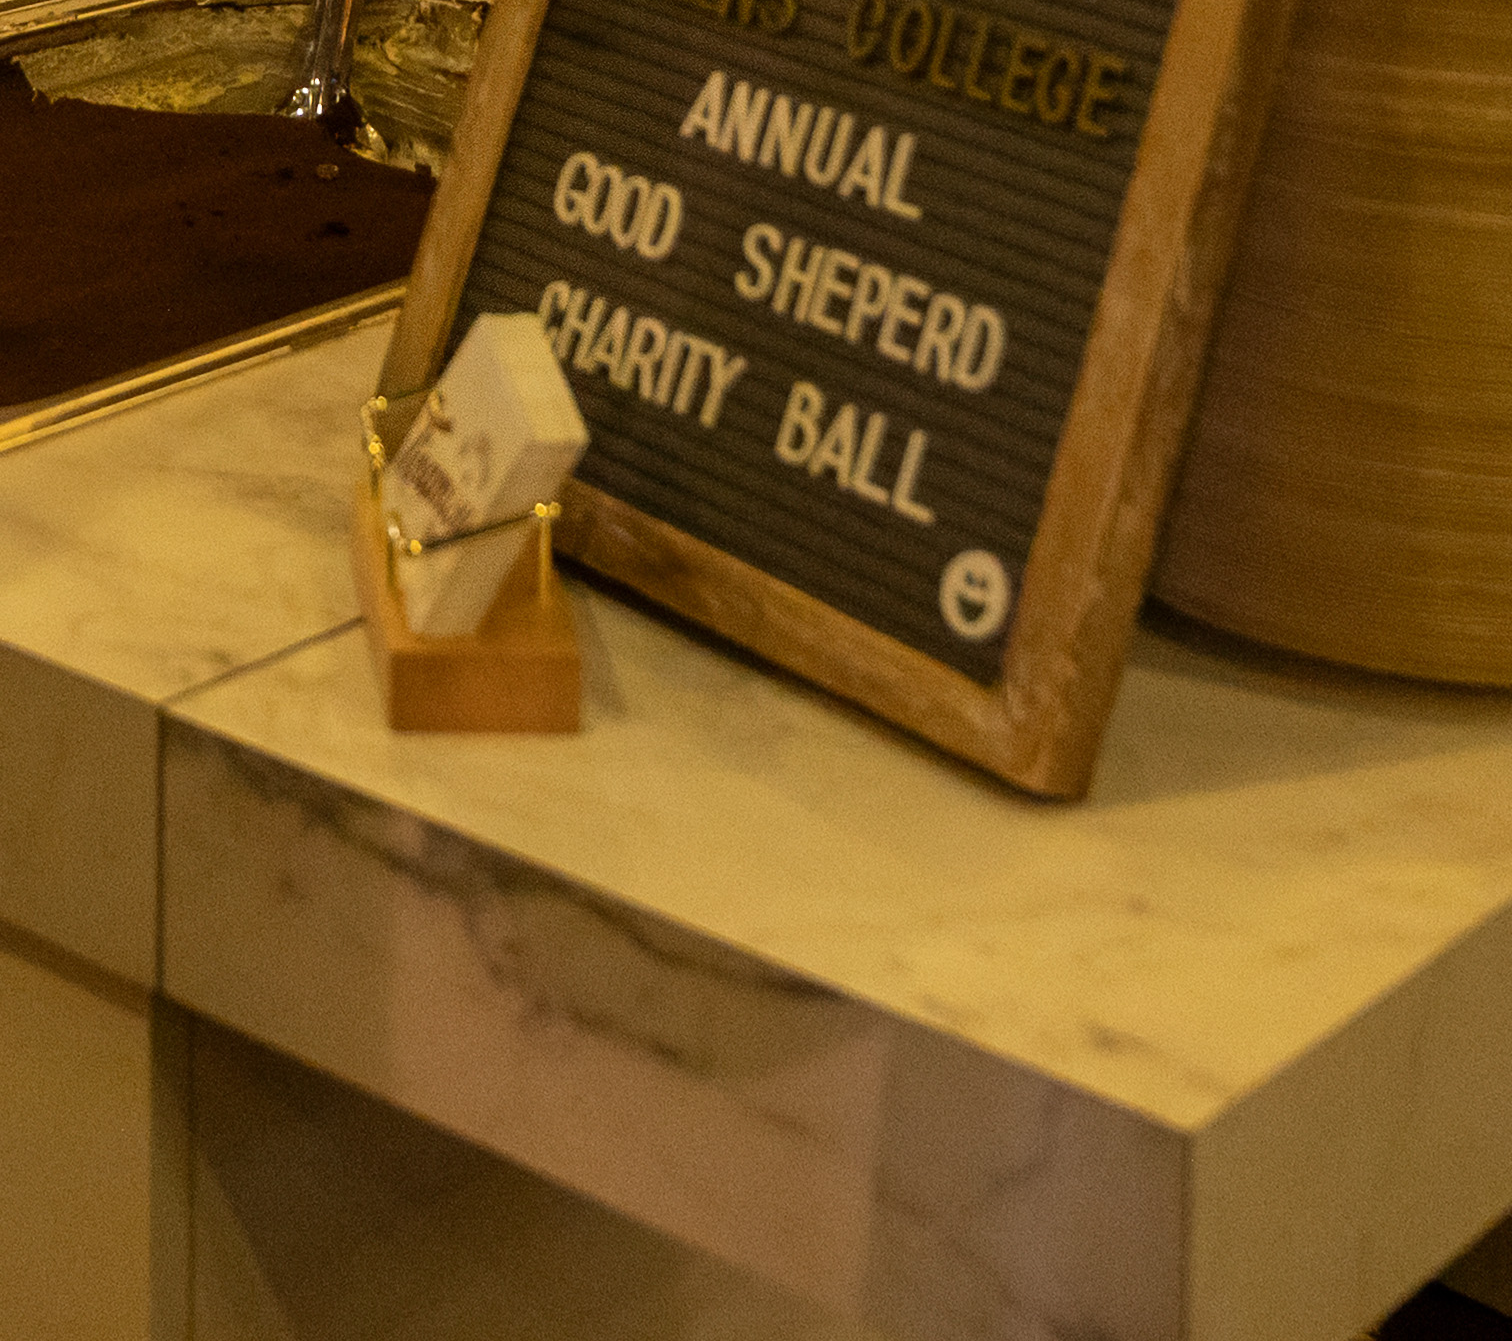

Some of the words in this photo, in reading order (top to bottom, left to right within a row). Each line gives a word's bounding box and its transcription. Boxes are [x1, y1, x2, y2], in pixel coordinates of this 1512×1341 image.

[679, 69, 924, 219] ANNUAL
[552, 149, 684, 260] GOOD
[733, 221, 1006, 391] SHEPERD
[537, 278, 749, 429] CHARITY
[775, 379, 936, 525] BALL
